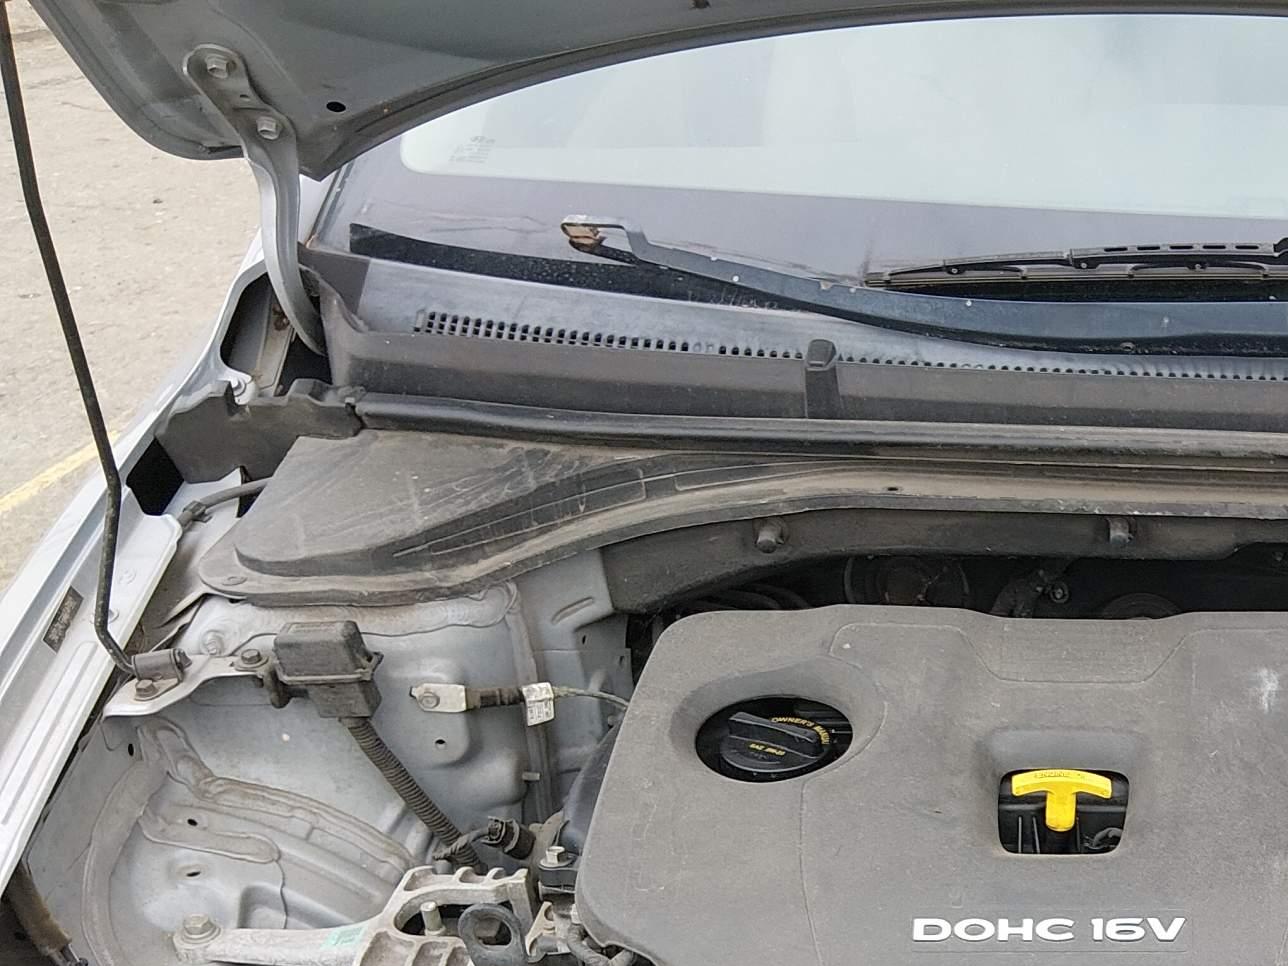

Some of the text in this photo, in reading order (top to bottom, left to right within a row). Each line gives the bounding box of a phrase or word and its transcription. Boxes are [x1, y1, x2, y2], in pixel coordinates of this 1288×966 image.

[771, 717, 815, 727] OWNER'S
[912, 917, 1186, 941] DOHC 16V
